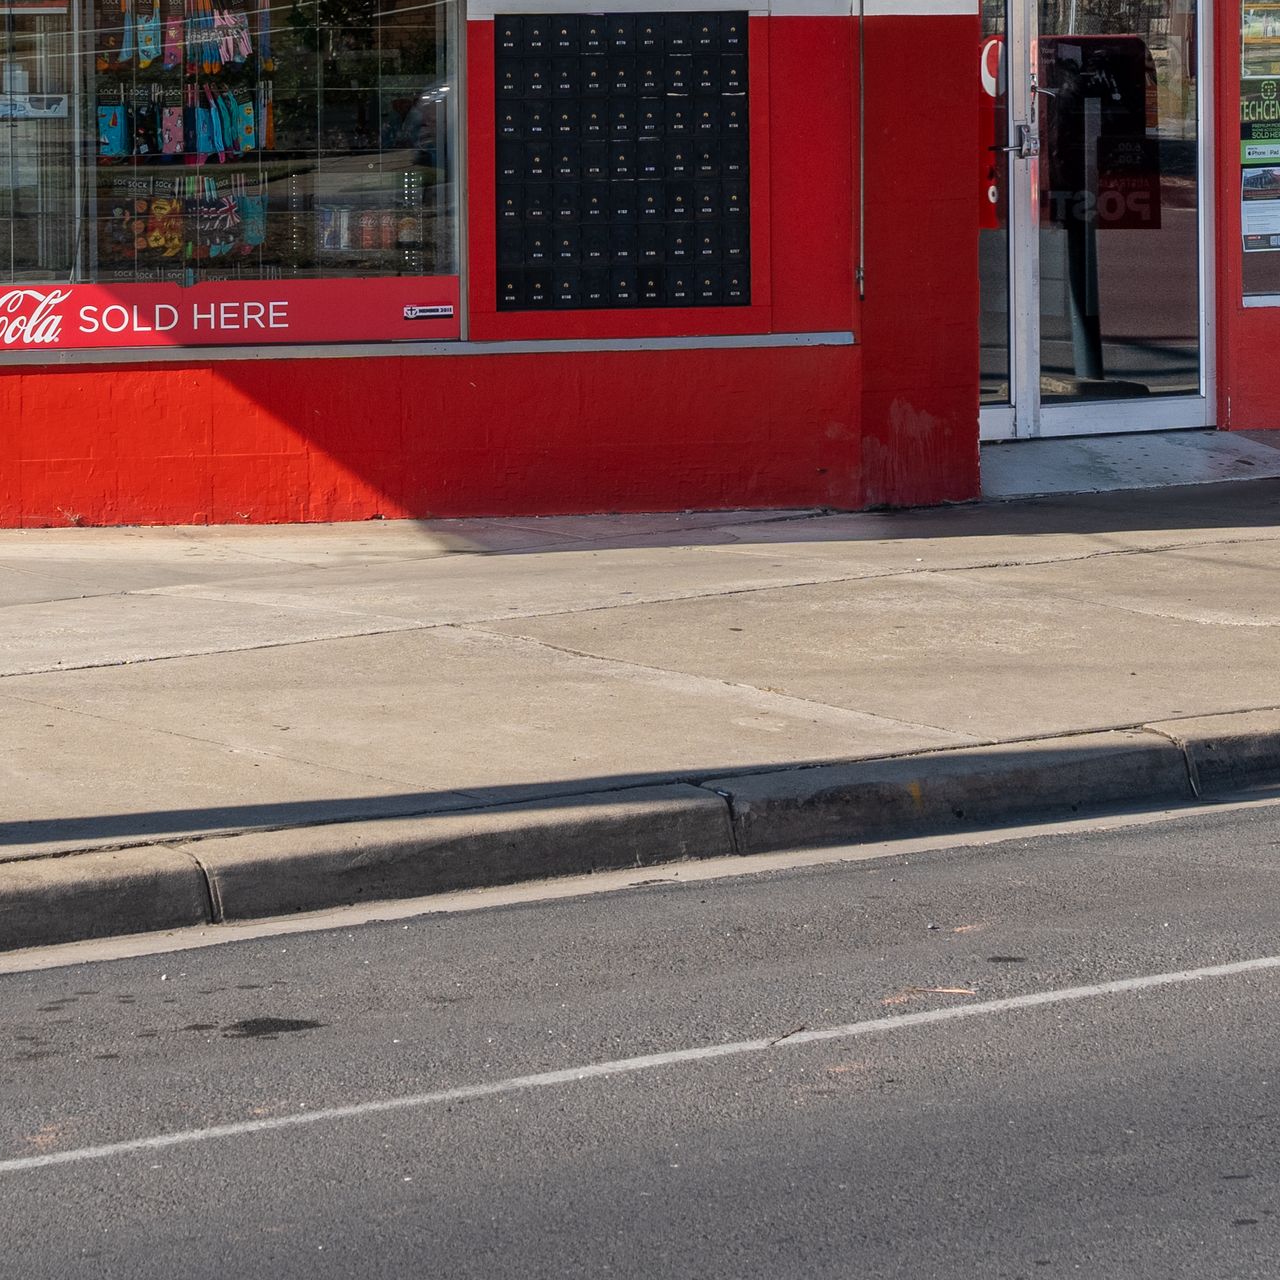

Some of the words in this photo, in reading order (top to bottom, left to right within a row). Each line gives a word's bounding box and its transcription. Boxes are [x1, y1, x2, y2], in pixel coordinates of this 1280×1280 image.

[1251, 131, 1269, 139] SOLD
[79, 304, 179, 334] SOLD
[192, 301, 289, 330] HERE
